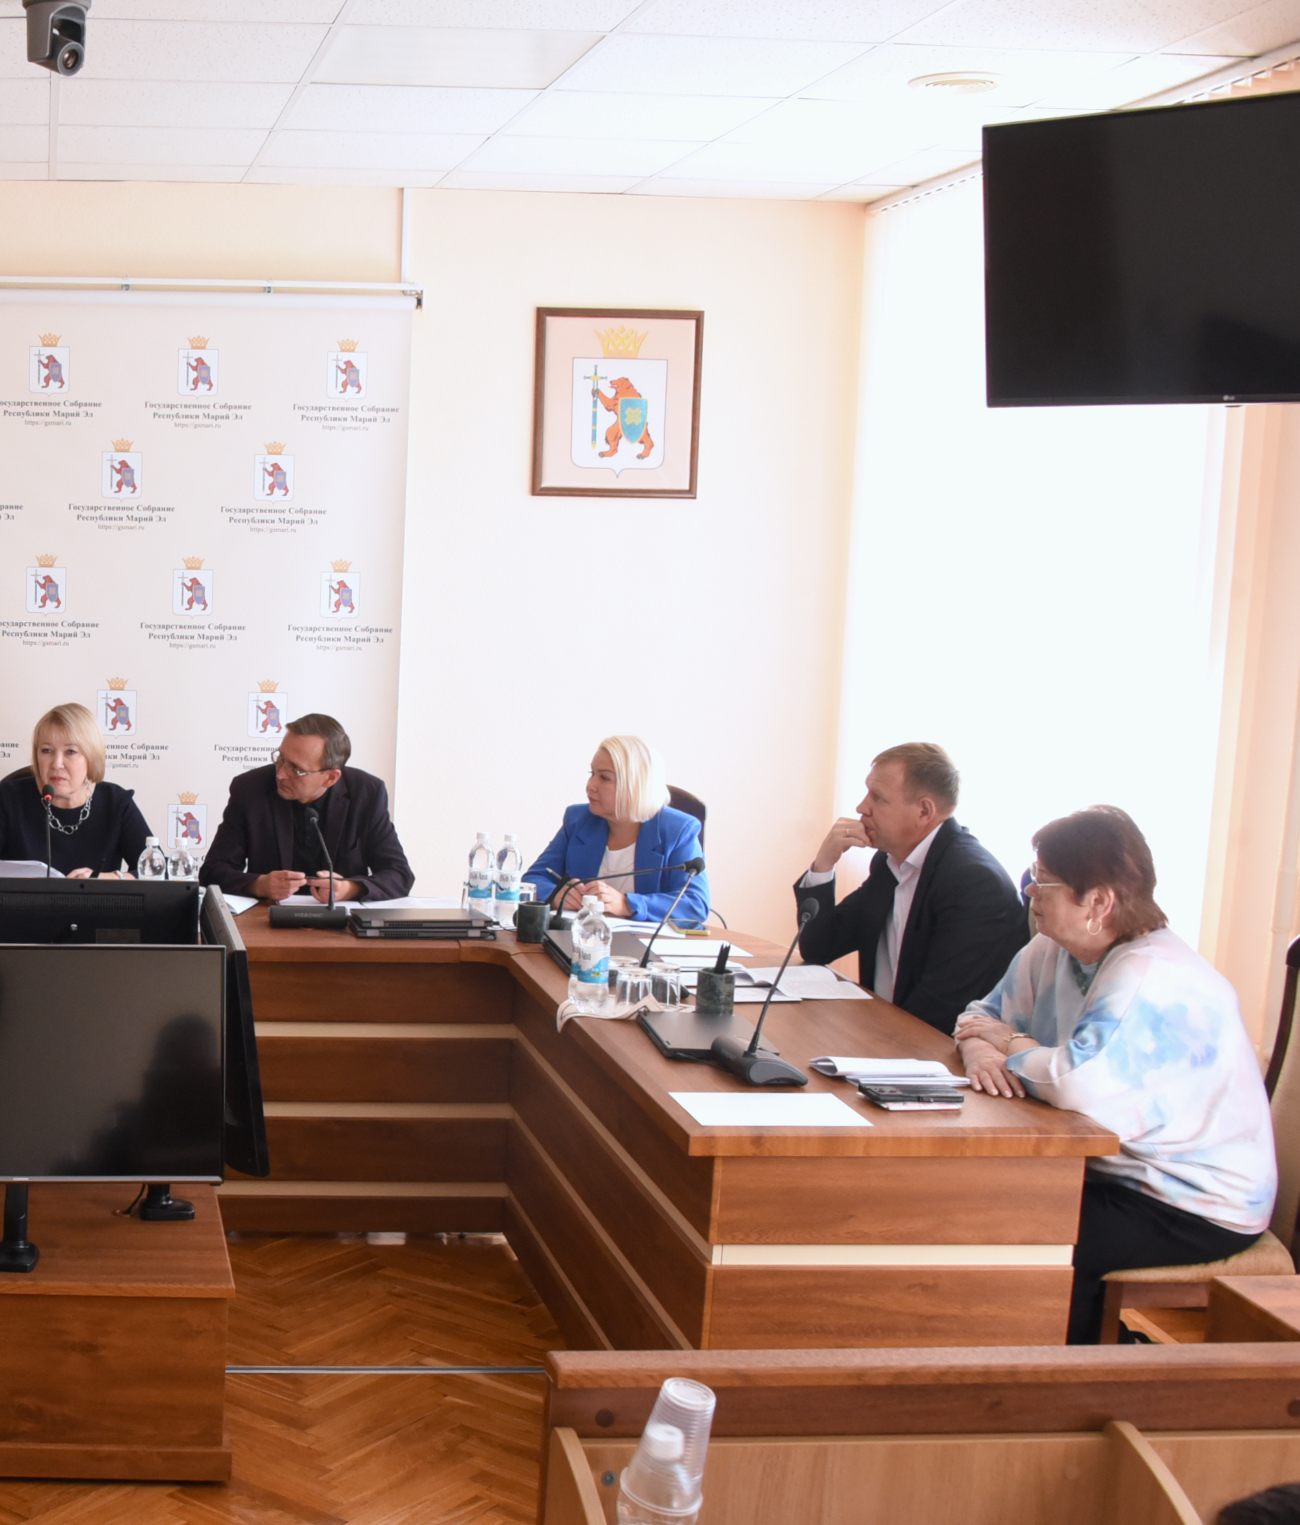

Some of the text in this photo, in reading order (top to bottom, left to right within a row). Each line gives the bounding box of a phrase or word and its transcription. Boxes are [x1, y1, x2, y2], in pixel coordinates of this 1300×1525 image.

[63, 400, 102, 409] Собрание
[145, 401, 252, 411] Государственное Собрание
[293, 404, 399, 414] Государственное Собрание
[3, 410, 50, 419] Республики
[53, 410, 80, 419] Марий
[153, 412, 200, 421] Республики
[203, 412, 230, 421] Марий
[301, 414, 347, 423] Республики
[350, 415, 377, 423] Марий
[69, 504, 175, 513] Государственное Собрание
[221, 506, 326, 516] Государственное Собрание
[77, 514, 123, 523] Республики
[126, 515, 153, 523] Марий
[229, 517, 274, 526] Республики
[277, 518, 304, 526] Марий
[61, 621, 99, 629] Собрание
[140, 622, 246, 632] Государственное Собрание
[288, 625, 393, 634] Государственное Собрание
[2, 630, 47, 639] Республики
[50, 631, 77, 639] Марий
[148, 633, 194, 642] Республики
[197, 633, 224, 642] Марий
[296, 635, 341, 644] Республики
[344, 636, 371, 644] Марий
[131, 743, 168, 752] Собрание
[120, 753, 147, 762] Марий
[222, 755, 268, 763] Республики
